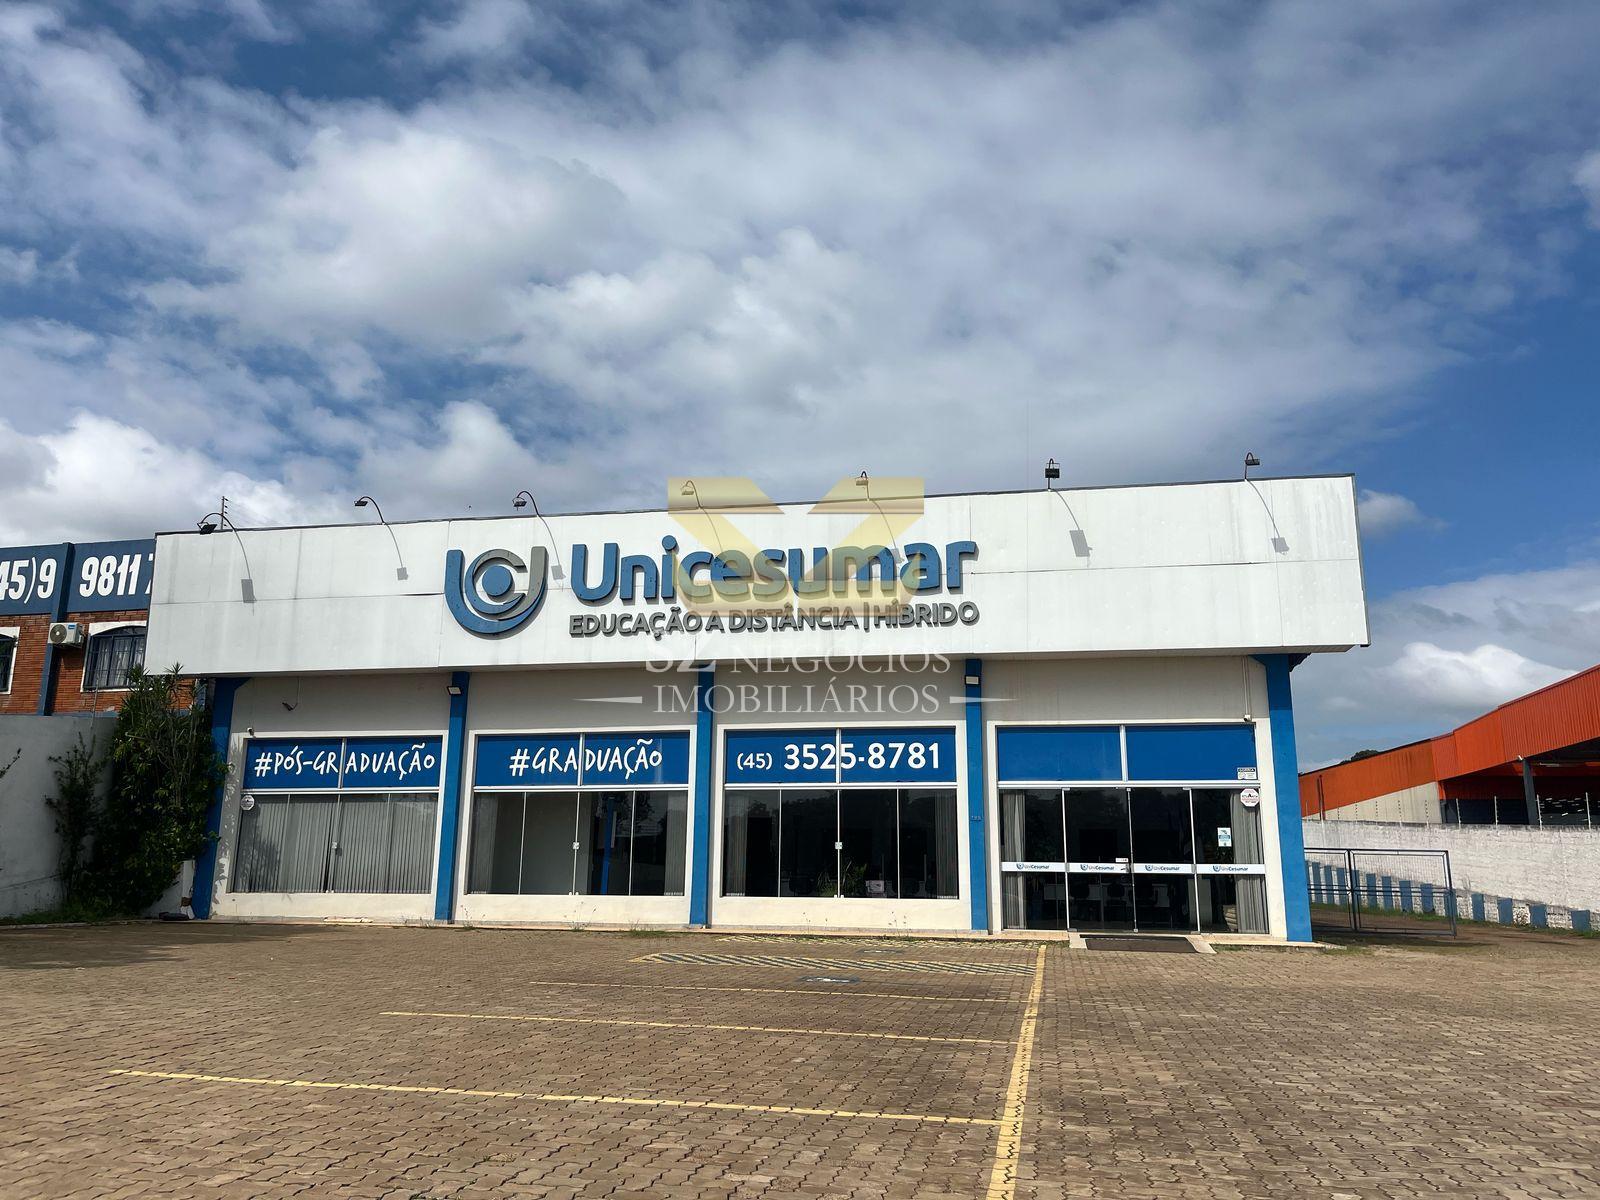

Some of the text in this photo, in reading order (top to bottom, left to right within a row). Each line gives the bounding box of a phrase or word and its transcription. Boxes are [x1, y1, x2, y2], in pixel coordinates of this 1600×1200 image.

[79, 554, 142, 598] 9811
[570, 535, 978, 604] Unicesumar
[569, 598, 979, 641] EDUCAÇÃO A DISTÂNCIA HÍBRIDO
[254, 742, 436, 781] #PÓS-GRADUAÇÃO
[509, 738, 663, 780] #GRADUAÇÃO
[736, 753, 773, 771] (45)
